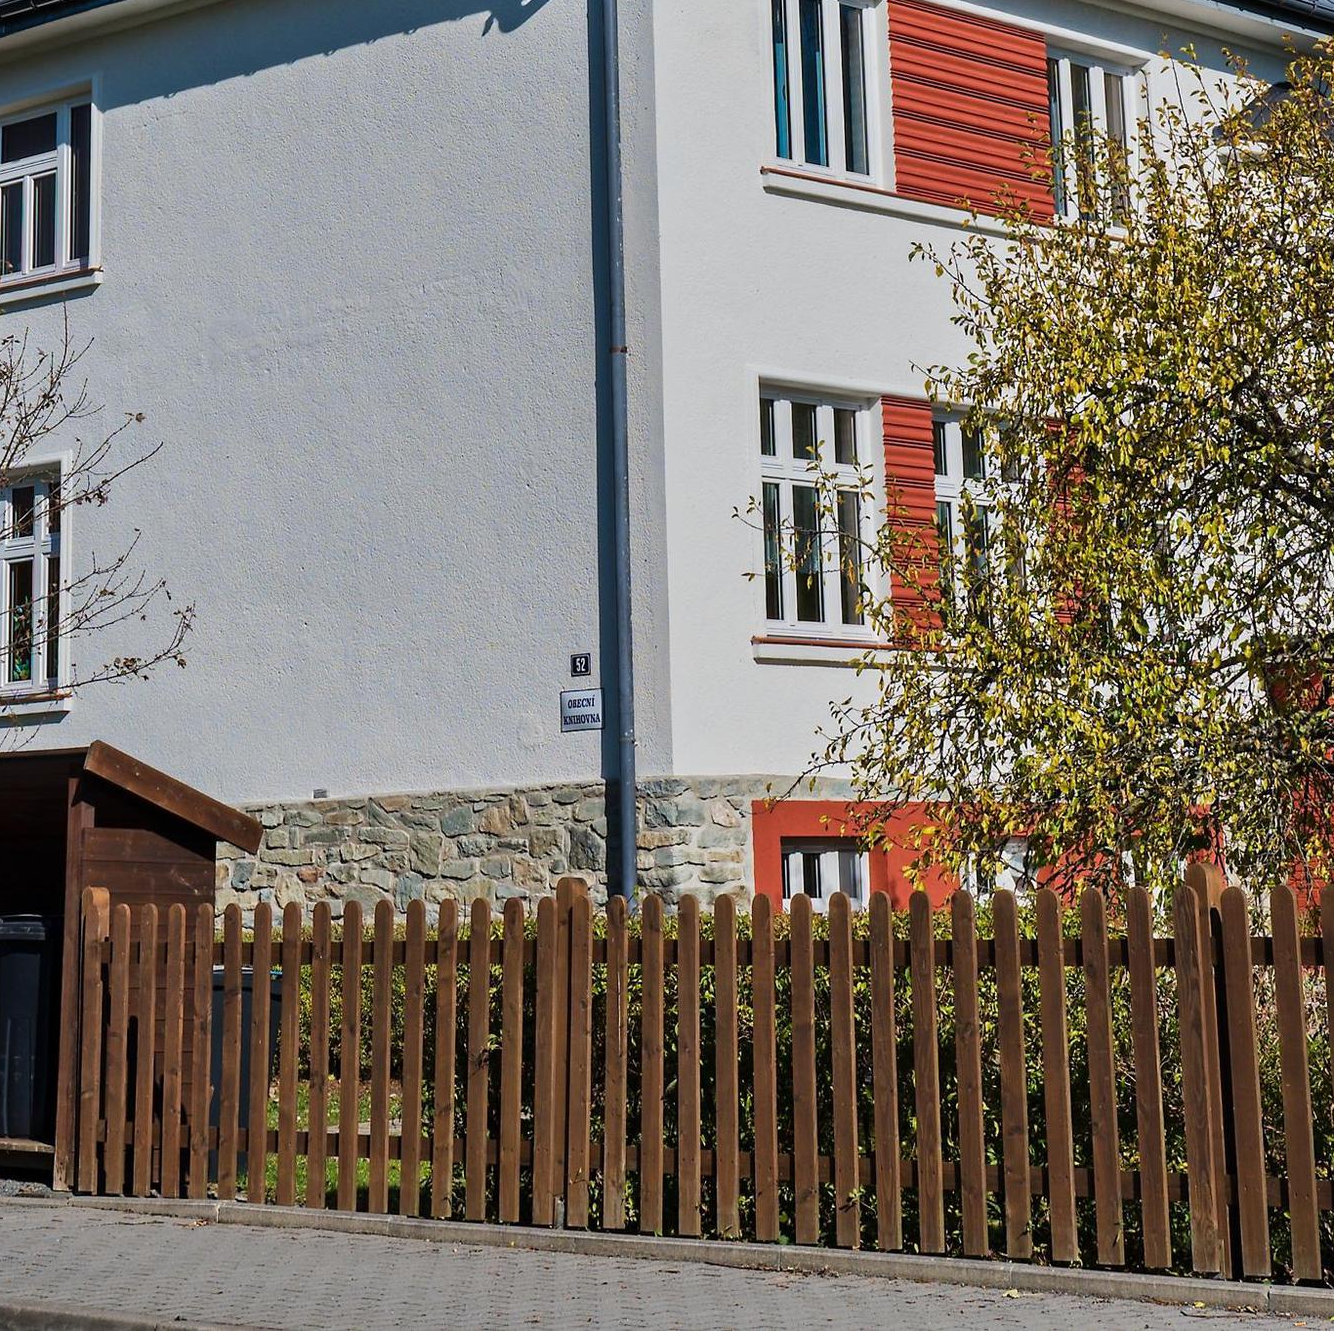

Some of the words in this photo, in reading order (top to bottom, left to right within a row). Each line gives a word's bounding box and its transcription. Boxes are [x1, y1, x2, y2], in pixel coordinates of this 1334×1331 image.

[576, 658, 586, 672] 52
[568, 695, 595, 708] OBECNÍ
[563, 714, 600, 725] KNIHOVNA
